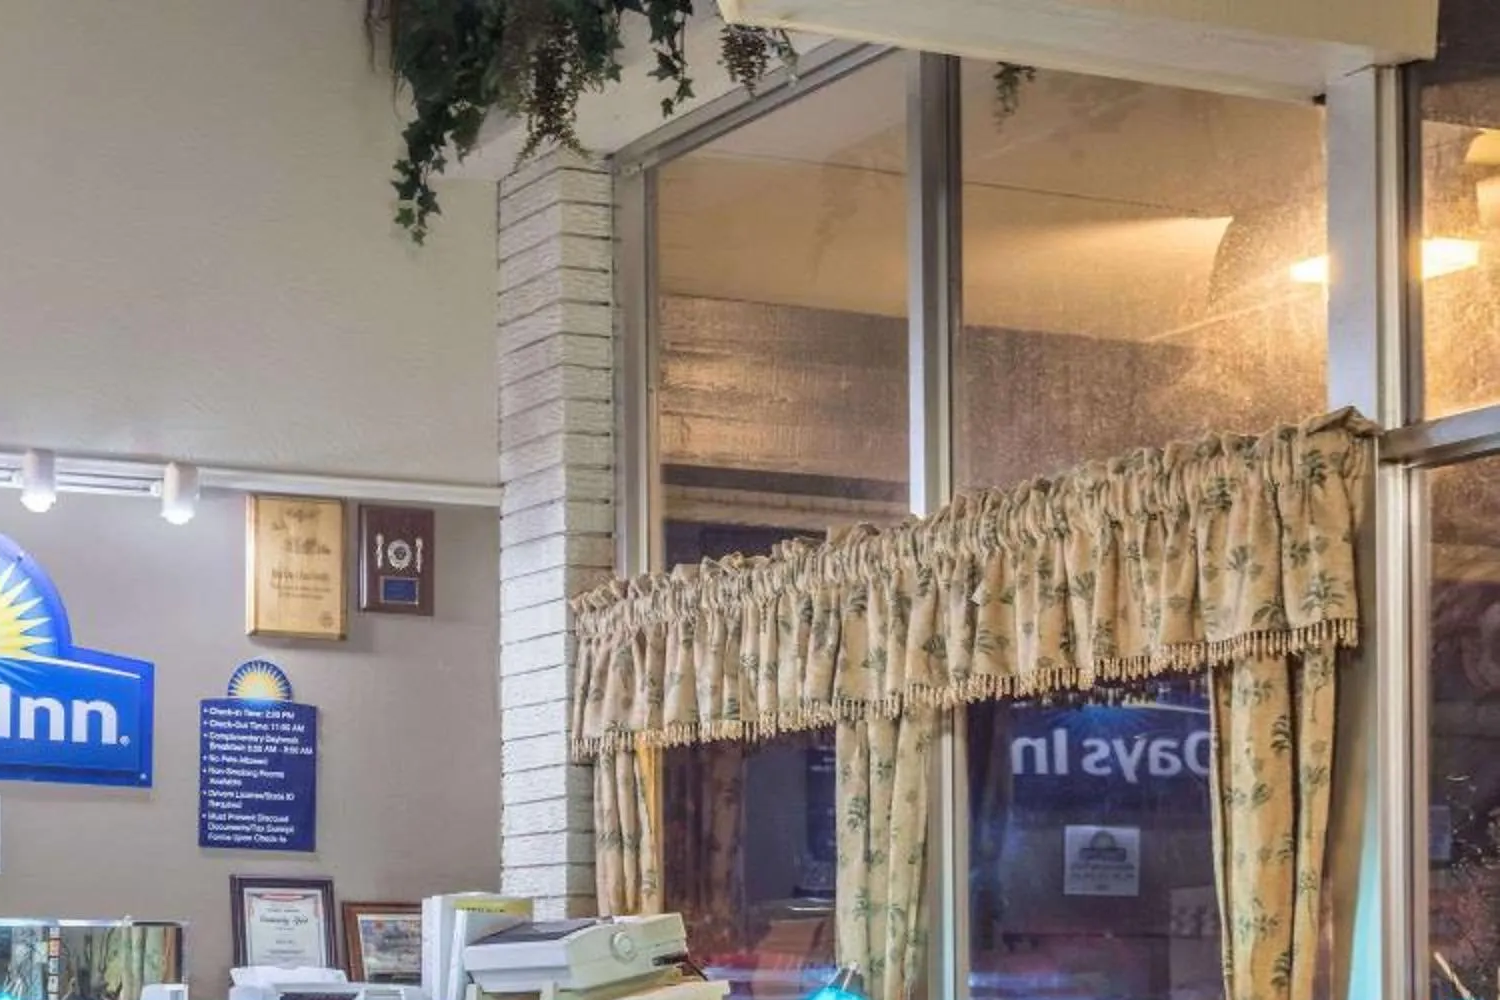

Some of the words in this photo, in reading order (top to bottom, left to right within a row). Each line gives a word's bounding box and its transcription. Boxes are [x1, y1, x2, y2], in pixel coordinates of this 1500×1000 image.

[281, 711, 295, 719] PM
[291, 723, 305, 732] AM
[263, 745, 277, 753] AM
[300, 747, 314, 755] AM
